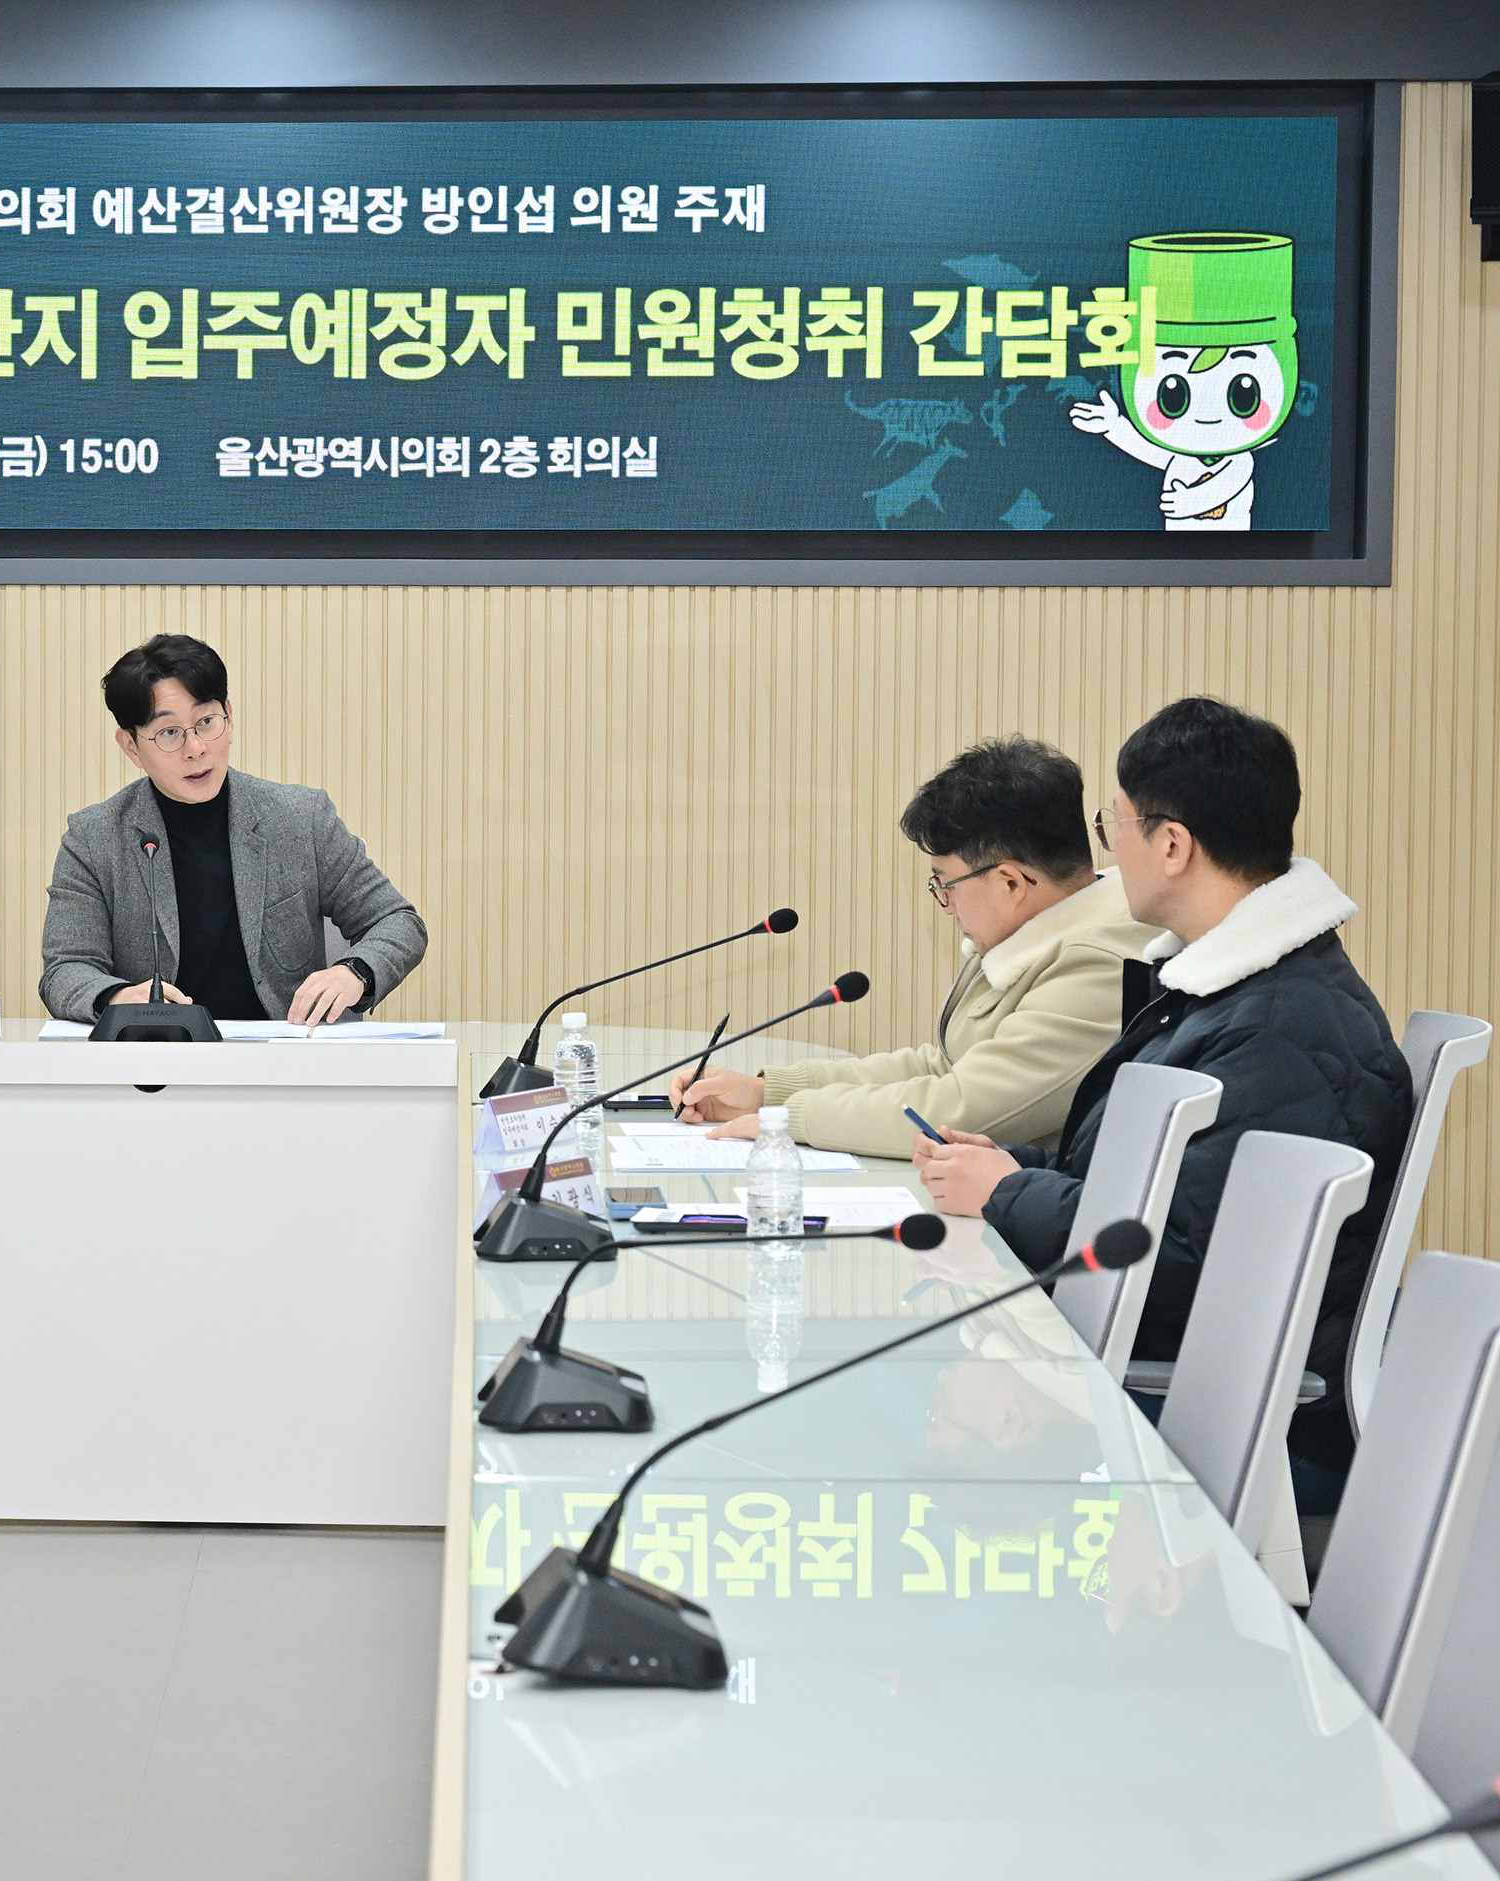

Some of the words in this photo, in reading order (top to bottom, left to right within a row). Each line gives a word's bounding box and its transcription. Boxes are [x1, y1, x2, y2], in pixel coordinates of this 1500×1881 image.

[93, 187, 409, 236] 예산결산위원장
[423, 186, 556, 235] 방인섭
[571, 186, 660, 234] 의원
[675, 185, 767, 234] 주재
[125, 288, 536, 381] 입주예정자
[558, 287, 885, 381] 민원청취
[910, 286, 1158, 380] 간담회
[60, 438, 160, 475] 15:00
[215, 437, 471, 479] 울산광역시의회
[479, 437, 541, 479] 2층
[548, 437, 659, 479] 회의실
